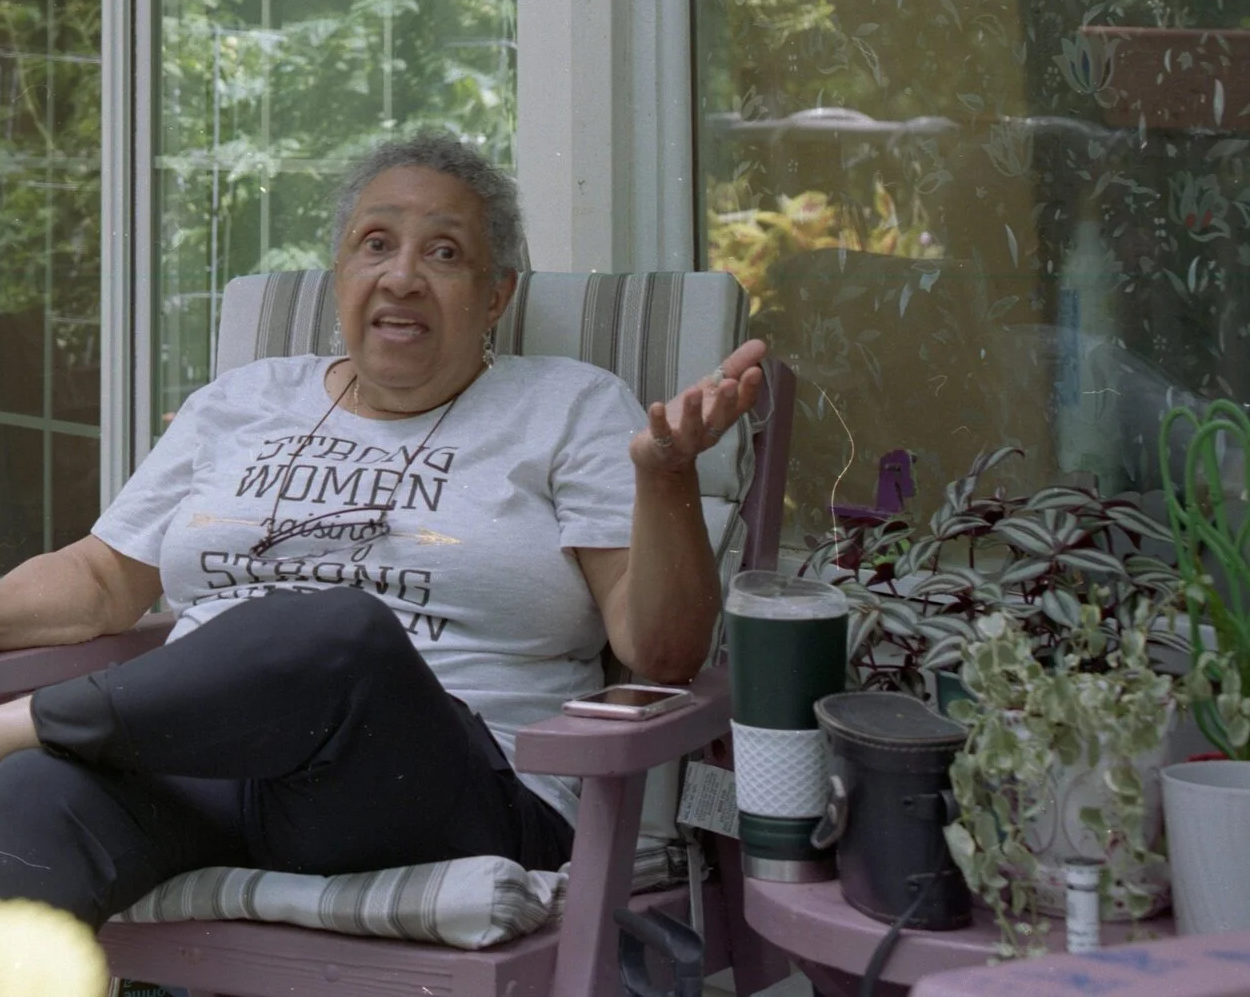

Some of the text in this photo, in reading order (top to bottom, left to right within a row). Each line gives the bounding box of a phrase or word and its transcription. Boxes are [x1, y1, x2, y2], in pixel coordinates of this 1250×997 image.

[256, 434, 459, 474] STRONG
[235, 464, 449, 512] WOMEN
[260, 513, 382, 561] raising
[200, 551, 432, 608] STRONG
